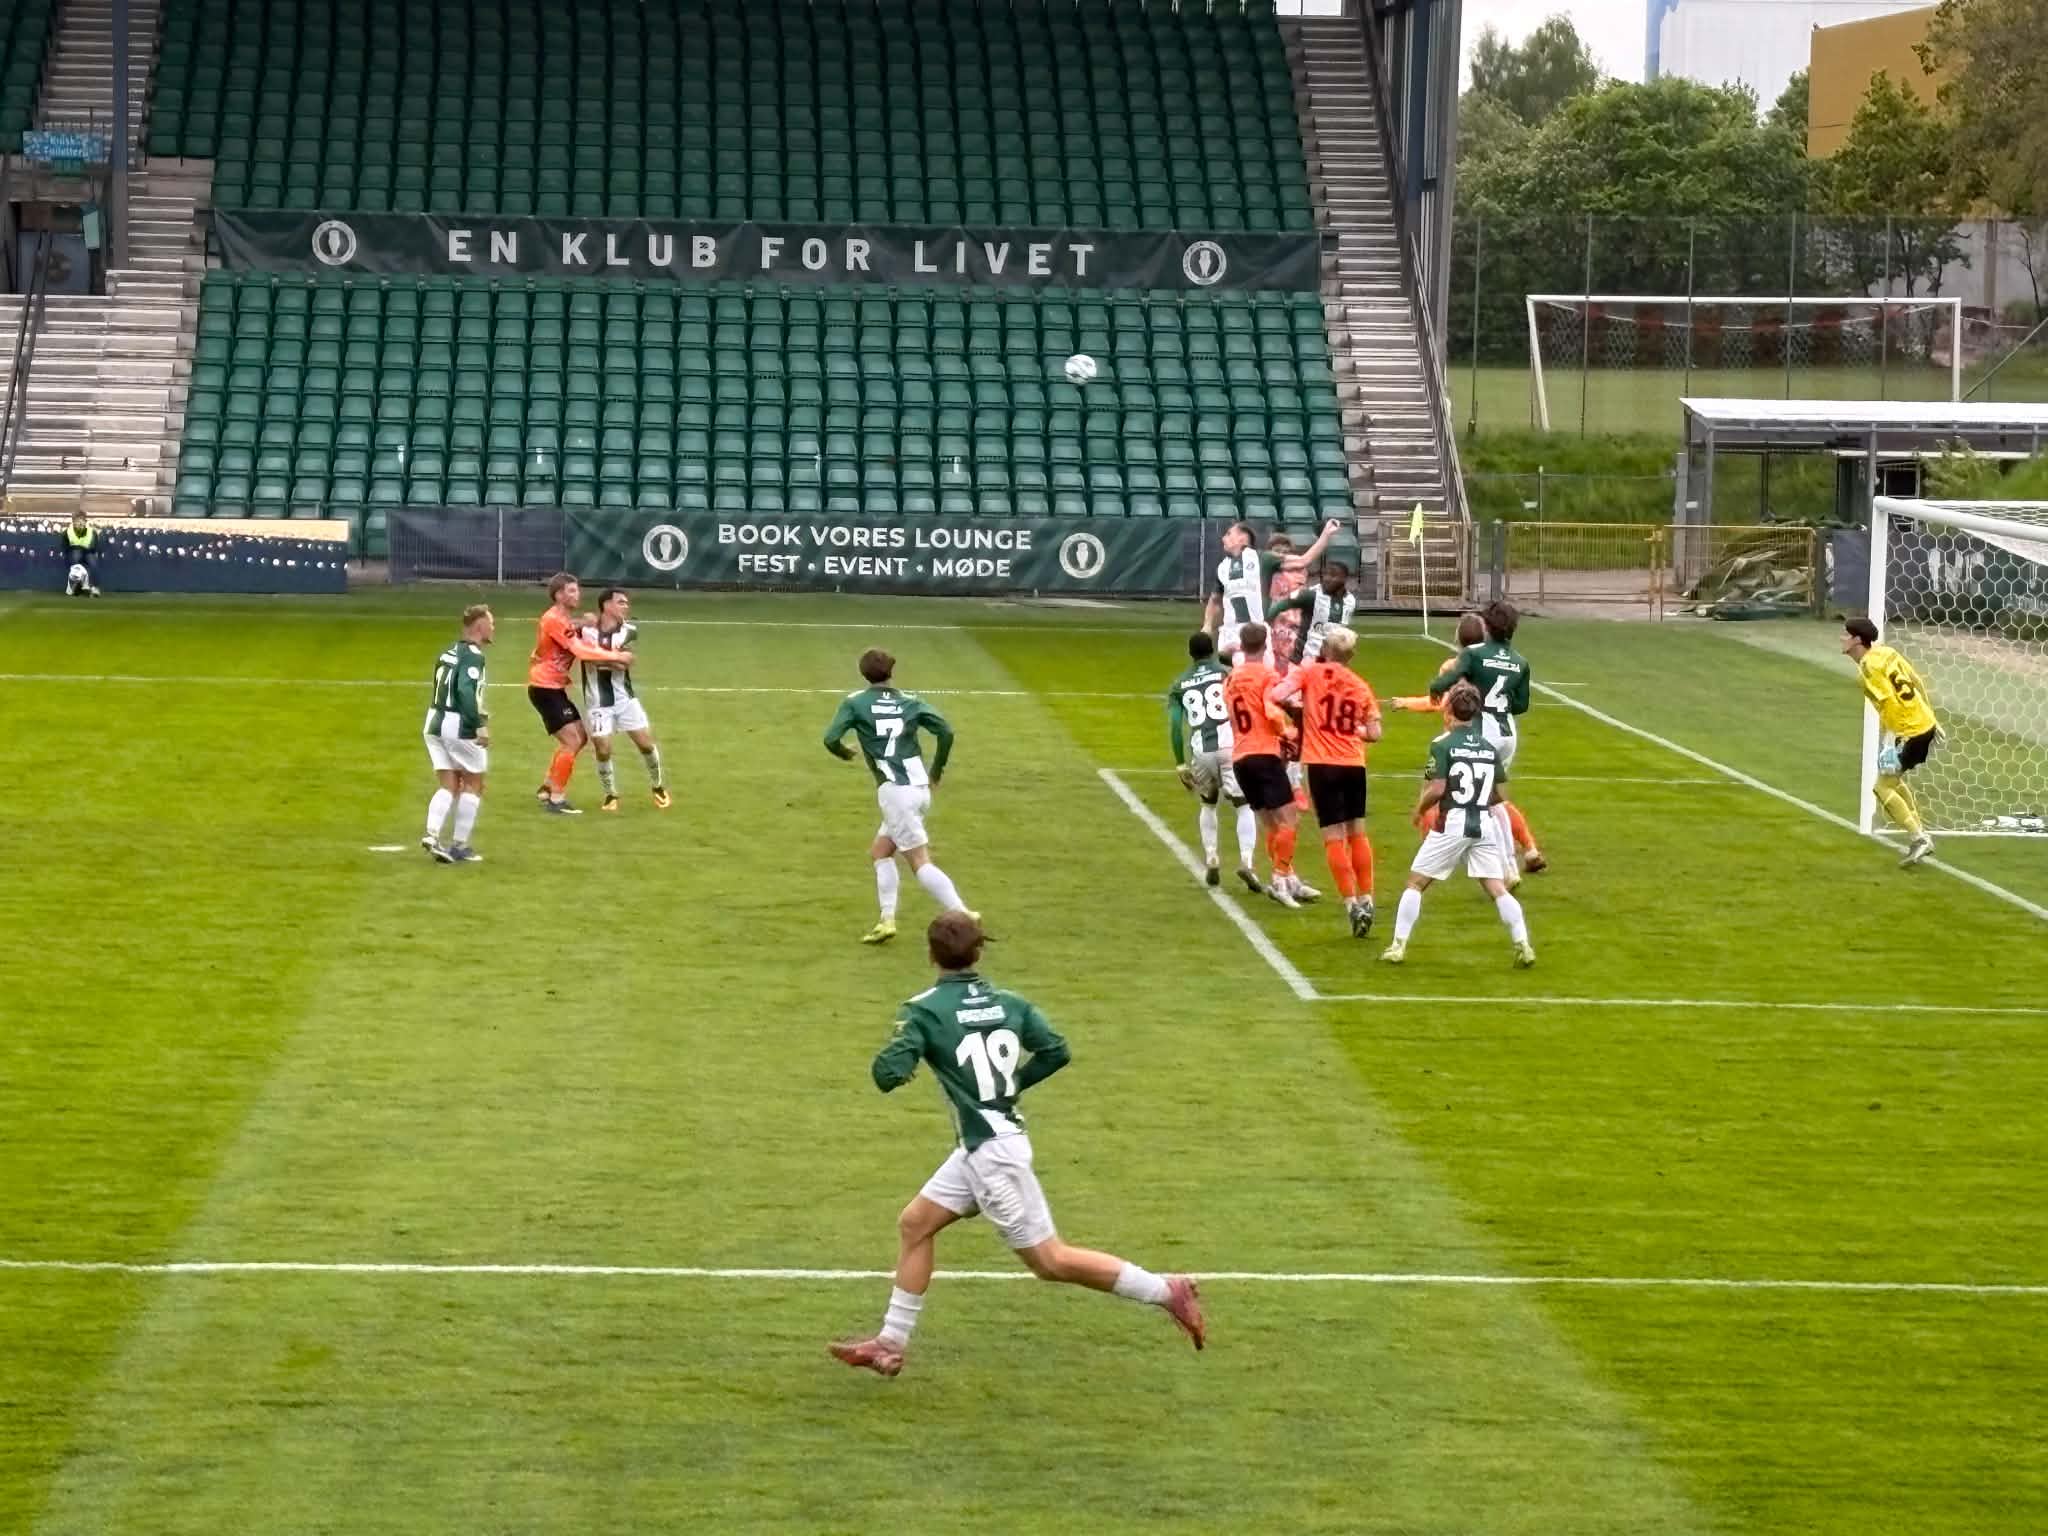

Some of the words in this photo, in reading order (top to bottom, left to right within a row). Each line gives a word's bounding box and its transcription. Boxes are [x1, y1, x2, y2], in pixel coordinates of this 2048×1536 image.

[448, 229, 517, 264] EN
[562, 232, 717, 268] KLUB
[761, 236, 870, 271] FOR
[914, 240, 1094, 276] LIVET
[718, 523, 800, 545] BOOK
[810, 525, 905, 548] VORES
[915, 528, 1032, 550] LOUNGE
[738, 554, 800, 573] FEST
[824, 556, 908, 577] EVENT
[932, 557, 1010, 578] MØDE
[1182, 683, 1229, 727] 88
[1319, 693, 1357, 735] 18
[1484, 675, 1509, 713] 4
[1232, 695, 1252, 735] 6
[875, 718, 905, 757] 7
[1449, 761, 1495, 805] 37
[955, 1029, 1020, 1102] 19
